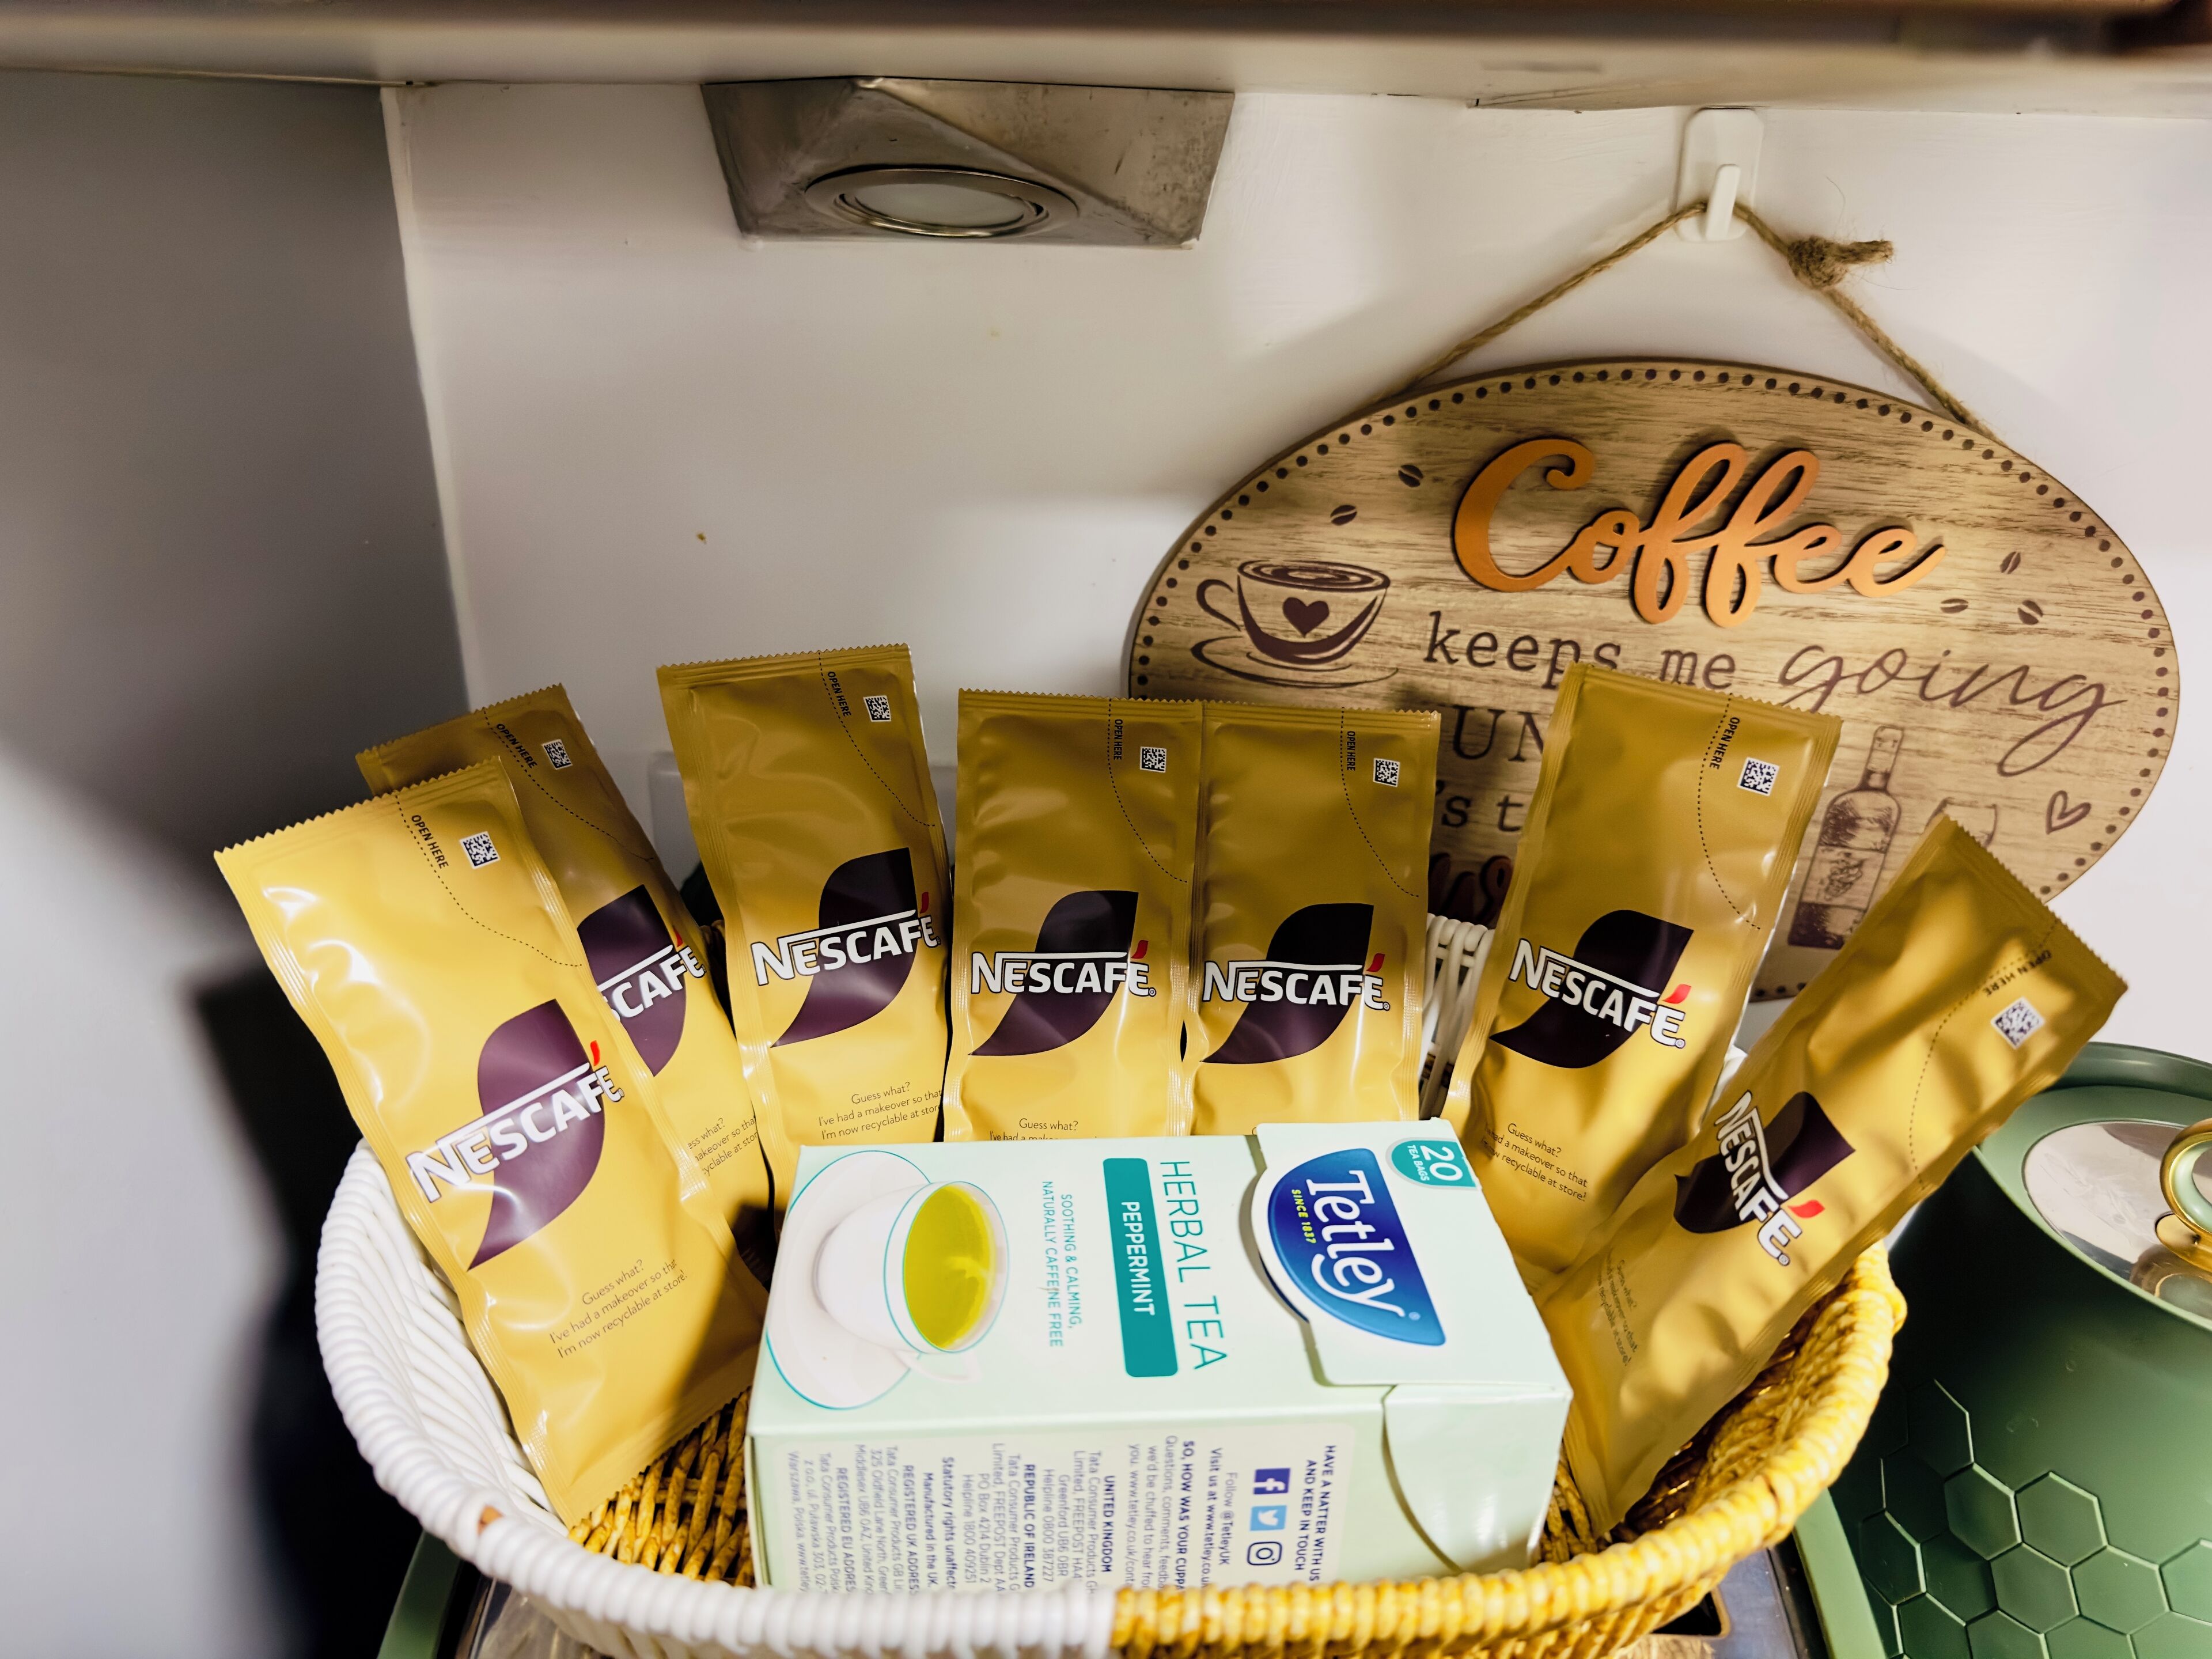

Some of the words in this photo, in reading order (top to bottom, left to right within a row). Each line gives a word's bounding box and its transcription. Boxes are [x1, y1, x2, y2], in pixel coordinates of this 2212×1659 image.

[1453, 438, 1946, 628] Coffee
[827, 671, 842, 694] OPEN
[835, 695, 851, 717] HERE
[1423, 611, 1622, 690] keeps
[1658, 647, 1736, 690] me
[1778, 644, 2128, 777] going
[495, 724, 520, 745] OPEN
[514, 745, 537, 768] HERE
[1113, 719, 1123, 739] OPEN
[1346, 730, 1355, 750] OPEN
[1452, 705, 1544, 762] UN
[1721, 717, 1740, 742] OPEN
[1113, 741, 1122, 760] HERE
[1346, 752, 1355, 771] HERE
[1709, 743, 1728, 770] HERE
[411, 815, 433, 841] OPEN
[427, 842, 448, 869] HERE
[597, 926, 706, 1021] CAFÉ
[819, 1116, 834, 1126] I've
[836, 1109, 854, 1122] had
[865, 1099, 910, 1115] makeover
[925, 1089, 942, 1100] that
[851, 1092, 881, 1104] Guess
[883, 1081, 910, 1097] what?
[700, 1118, 725, 1139] what?
[731, 1128, 740, 1137] so
[821, 1130, 836, 1140] I'm
[839, 1126, 858, 1137] now
[861, 1112, 908, 1131] recyclable
[910, 1109, 919, 1118] at
[990, 1131, 1001, 1141] I've
[1003, 1132, 1018, 1140] had
[1019, 1118, 1047, 1129] Guess
[1050, 1120, 1078, 1131] what?
[1508, 1123, 1532, 1143] Guess
[1535, 1140, 1562, 1157] what?
[733, 1143, 742, 1153] at
[1407, 1145, 1419, 1159] TEA
[1413, 1160, 1430, 1181] BAGS
[1419, 1145, 1464, 1182] 20
[1511, 1144, 1554, 1170] makeover
[1555, 1166, 1566, 1176] so
[1568, 1171, 1588, 1187] that
[1501, 1155, 1546, 1181] recyclable
[1547, 1178, 1557, 1187] at
[1558, 1184, 1586, 1202] store!
[1042, 1181, 1056, 1243] NATURALLY
[1060, 1194, 1076, 1251] SOOTHING
[1160, 1161, 1210, 1282] HERBAL
[1291, 1189, 1308, 1218] SINCE
[1301, 1221, 1316, 1243] 1837
[1121, 1202, 1155, 1315] PEPPERMINT
[1305, 1169, 1406, 1318] Tetley
[582, 1282, 615, 1305] Guess
[615, 1259, 643, 1285] what?
[1045, 1248, 1060, 1308] CAFFENE
[550, 1330, 569, 1343] I've
[570, 1312, 592, 1332] had
[593, 1311, 600, 1319] a
[601, 1279, 647, 1313] makeover
[650, 1272, 661, 1283] so
[662, 1258, 677, 1274] that
[557, 1345, 576, 1358] I'm
[578, 1330, 600, 1348] now
[603, 1297, 650, 1332] recyclable
[652, 1289, 662, 1300] at
[664, 1269, 687, 1293] store!
[1065, 1267, 1082, 1328] CALMING,
[1048, 1313, 1063, 1346] FREE
[1184, 1296, 1227, 1369] TEA
[1089, 1451, 1101, 1473] Tata
[1146, 1446, 1158, 1471] we'd
[1162, 1435, 1177, 1492] Questions,
[1180, 1441, 1194, 1459] SO,
[1209, 1448, 1221, 1471] Visit
[1322, 1445, 1335, 1475] HAVE
[941, 1457, 954, 1508] Statutory
[1072, 1450, 1085, 1494] Limited,
[1146, 1474, 1158, 1487] be
[1180, 1464, 1192, 1491] HOW
[1208, 1475, 1217, 1487] us
[1223, 1472, 1237, 1507] Follow
[1305, 1460, 1316, 1484] AND
[923, 1472, 935, 1540] Manufactured
[1024, 1464, 1035, 1520] REPUBLIC
[1041, 1469, 1055, 1512] Helpline
[1057, 1474, 1070, 1528] Greenford
[1087, 1476, 1100, 1530] Consumer
[1103, 1475, 1114, 1517] UNITED
[1207, 1491, 1217, 1500] at
[1301, 1488, 1313, 1516] KEEP
[1071, 1498, 1085, 1554] FREEPOST
[1144, 1491, 1156, 1531] chuffed
[1158, 1496, 1172, 1552] comments,
[1179, 1496, 1190, 1521] WAS
[1299, 1520, 1309, 1530] IN
[1315, 1491, 1330, 1533] NATTER
[942, 1512, 955, 1541] rights
[1024, 1524, 1035, 1538] OF
[1042, 1515, 1055, 1544] 0800
[1057, 1531, 1069, 1552] UB6
[1143, 1534, 1154, 1544] to
[1176, 1525, 1188, 1554] YOUR
[1218, 1512, 1233, 1565] @TetleyUK
[926, 1543, 935, 1551] in
[926, 1554, 937, 1569] the
[1086, 1533, 1099, 1577] Products
[1101, 1521, 1112, 1572] KINGDOM
[1142, 1547, 1154, 1569] hear
[1294, 1535, 1308, 1570] TOUCH
[1311, 1537, 1324, 1565] WITH
[927, 1572, 938, 1586] UK.
[1024, 1542, 1035, 1588] IRELAND
[1042, 1548, 1054, 1582] 387227
[1057, 1555, 1069, 1576] 0BR
[1309, 1568, 1320, 1581] US
